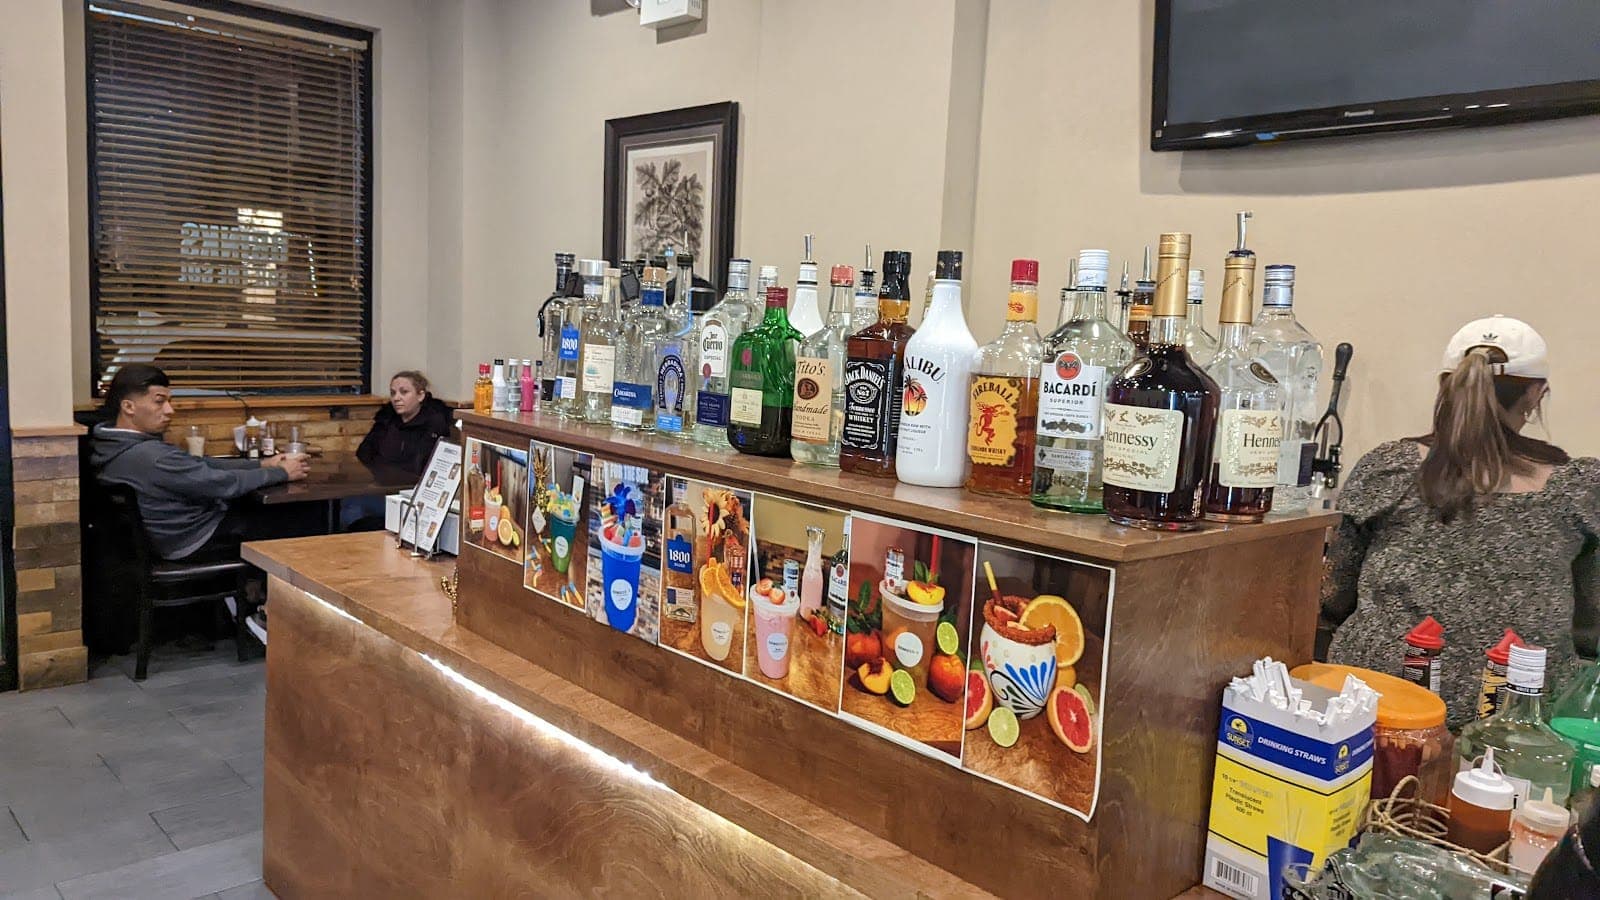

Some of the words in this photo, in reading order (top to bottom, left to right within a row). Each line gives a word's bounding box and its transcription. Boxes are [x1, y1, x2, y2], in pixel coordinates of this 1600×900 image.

[561, 338, 578, 351] 1800
[972, 382, 1013, 403] FIREBALL
[1043, 381, 1098, 398] BACARDÍ
[1104, 426, 1159, 451] Hennessy
[669, 548, 690, 564] 1800
[1226, 731, 1251, 748] SUNSET
[1257, 736, 1294, 755] DRINKING
[1294, 748, 1327, 765] STRAWS
